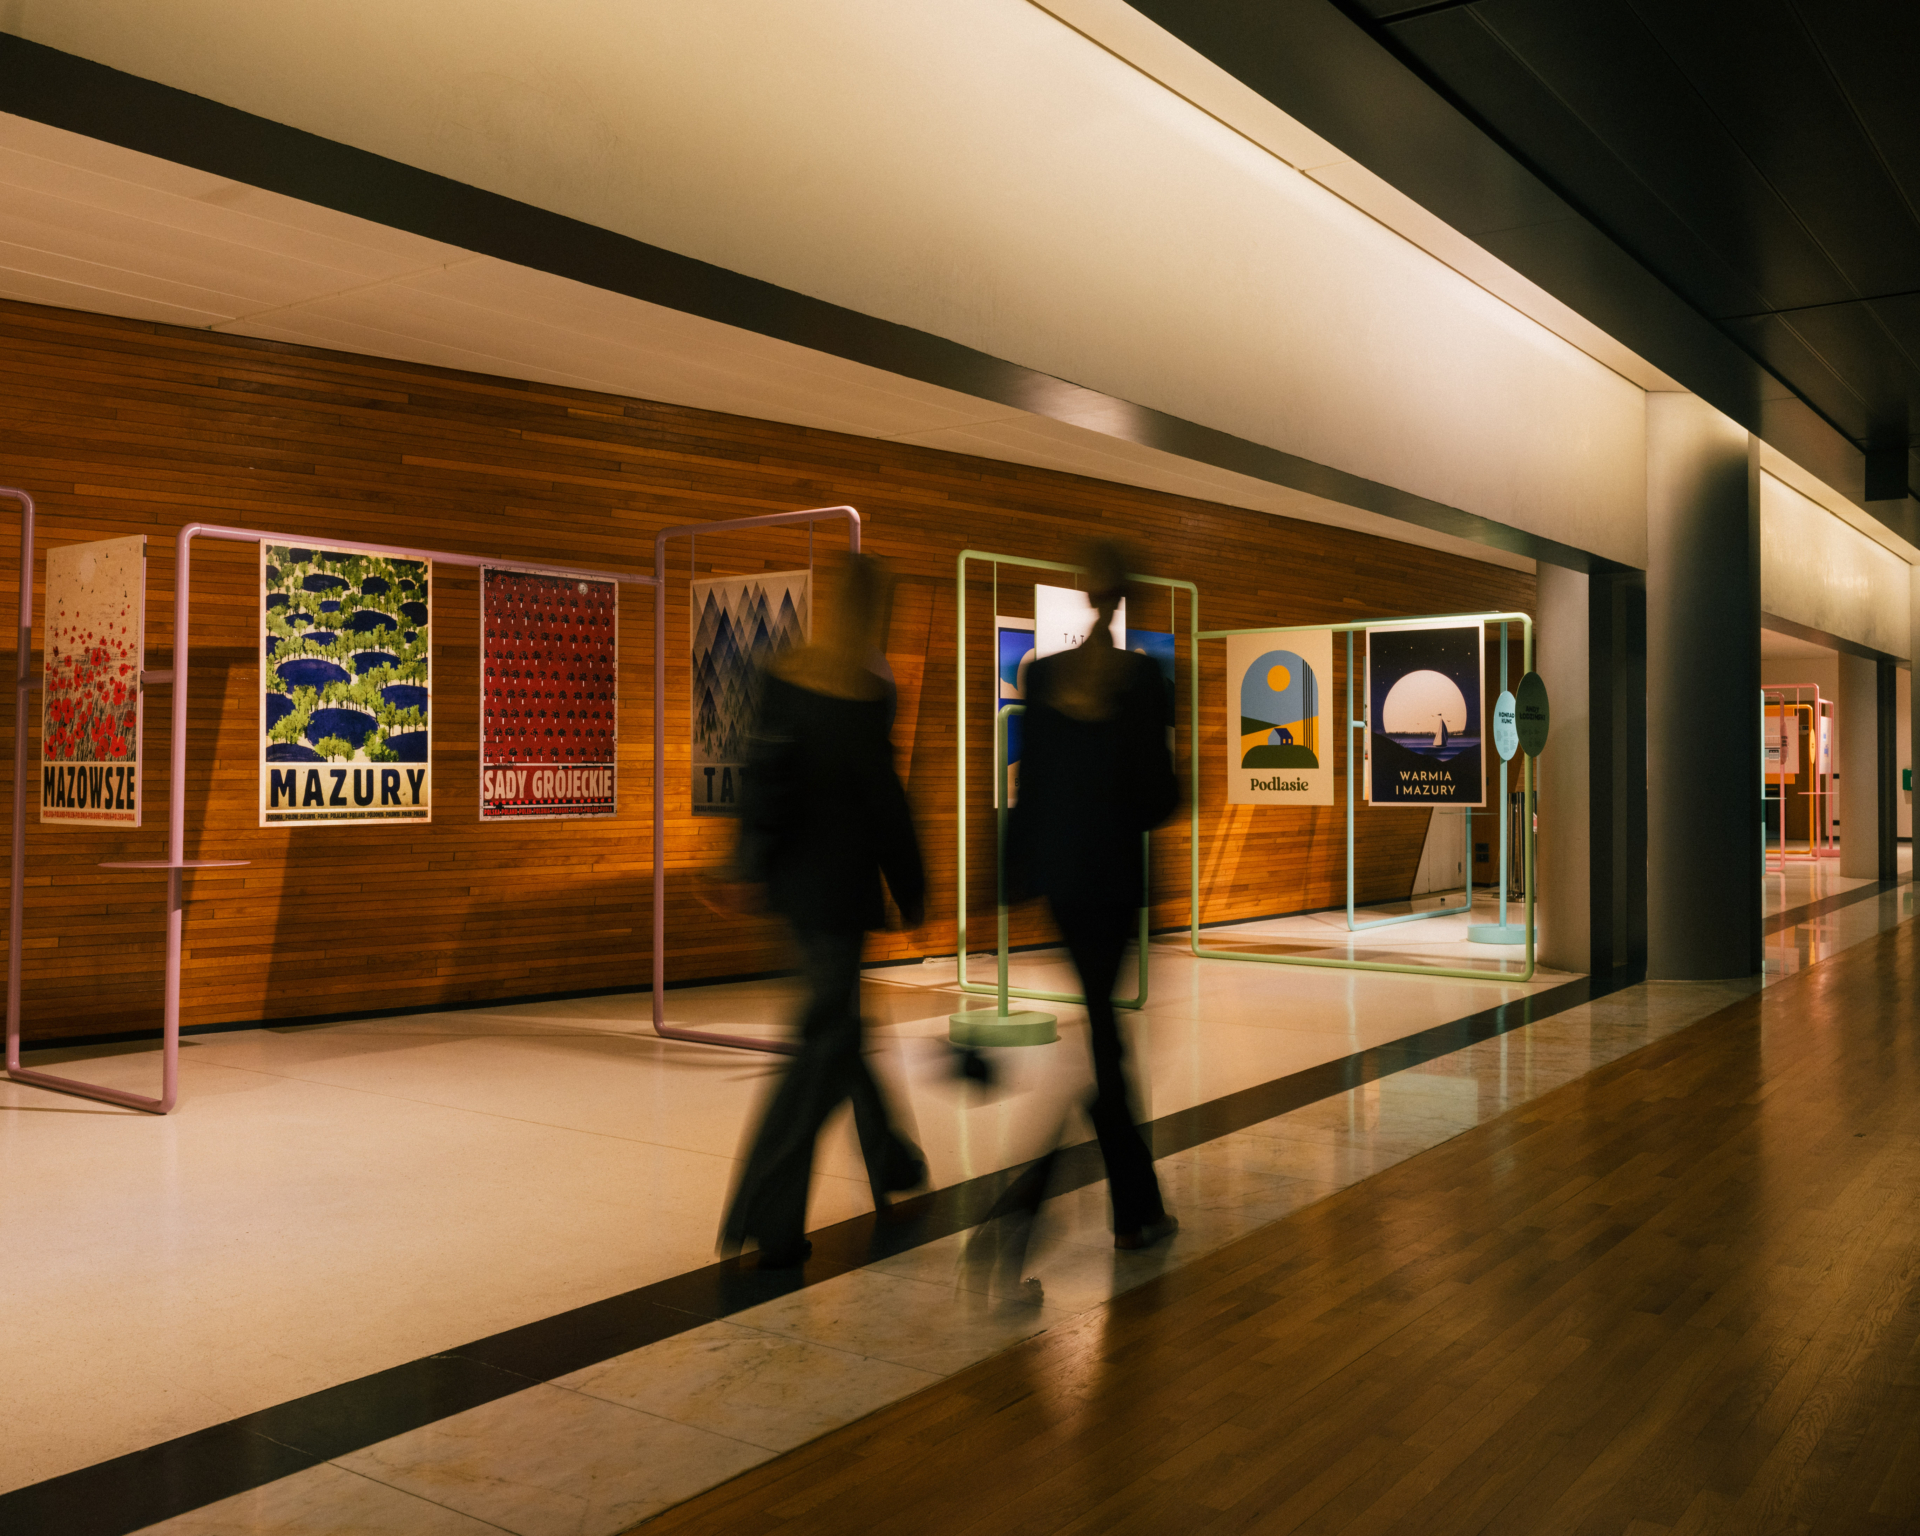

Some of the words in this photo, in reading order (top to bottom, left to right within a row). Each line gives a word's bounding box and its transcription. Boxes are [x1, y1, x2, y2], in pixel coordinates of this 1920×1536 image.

[484, 769, 527, 799] SADY
[1250, 776, 1309, 791] Podlasie
[1399, 770, 1452, 781] WARMIA
[43, 765, 135, 809] MAZOWSZE
[270, 768, 426, 807] MAZURY
[1395, 785, 1399, 796] I
[1402, 784, 1456, 796] MAZURY
